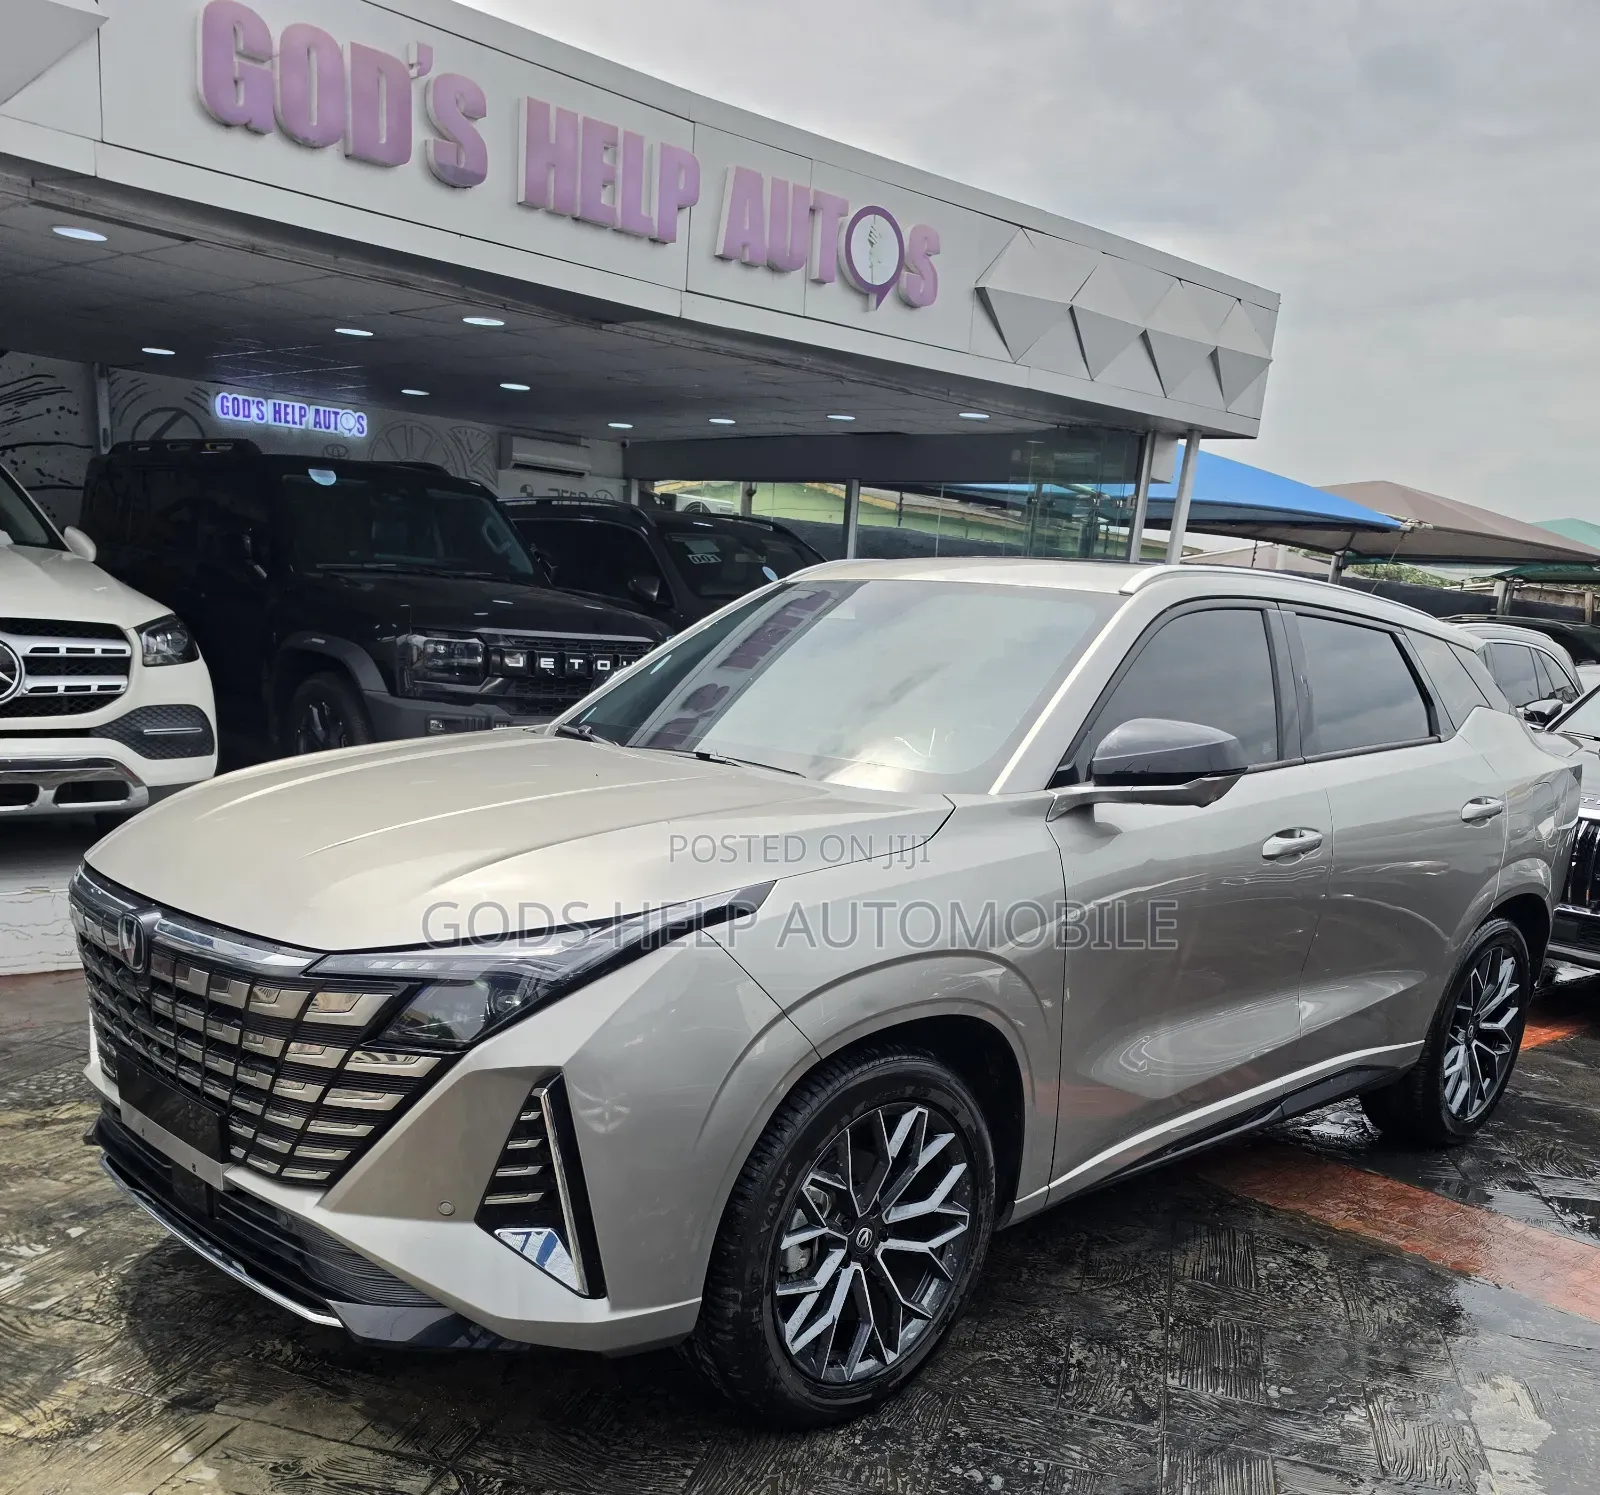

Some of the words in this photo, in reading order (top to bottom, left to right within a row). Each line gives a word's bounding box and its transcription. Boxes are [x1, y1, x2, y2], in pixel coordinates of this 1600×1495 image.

[197, 0, 488, 189] GOD'S
[517, 96, 700, 244] HELP
[714, 165, 941, 311] AUTOS
[220, 394, 265, 421] GOD'S
[272, 402, 308, 427] HELP
[313, 408, 366, 435] AUTOS
[691, 555, 719, 563] 001
